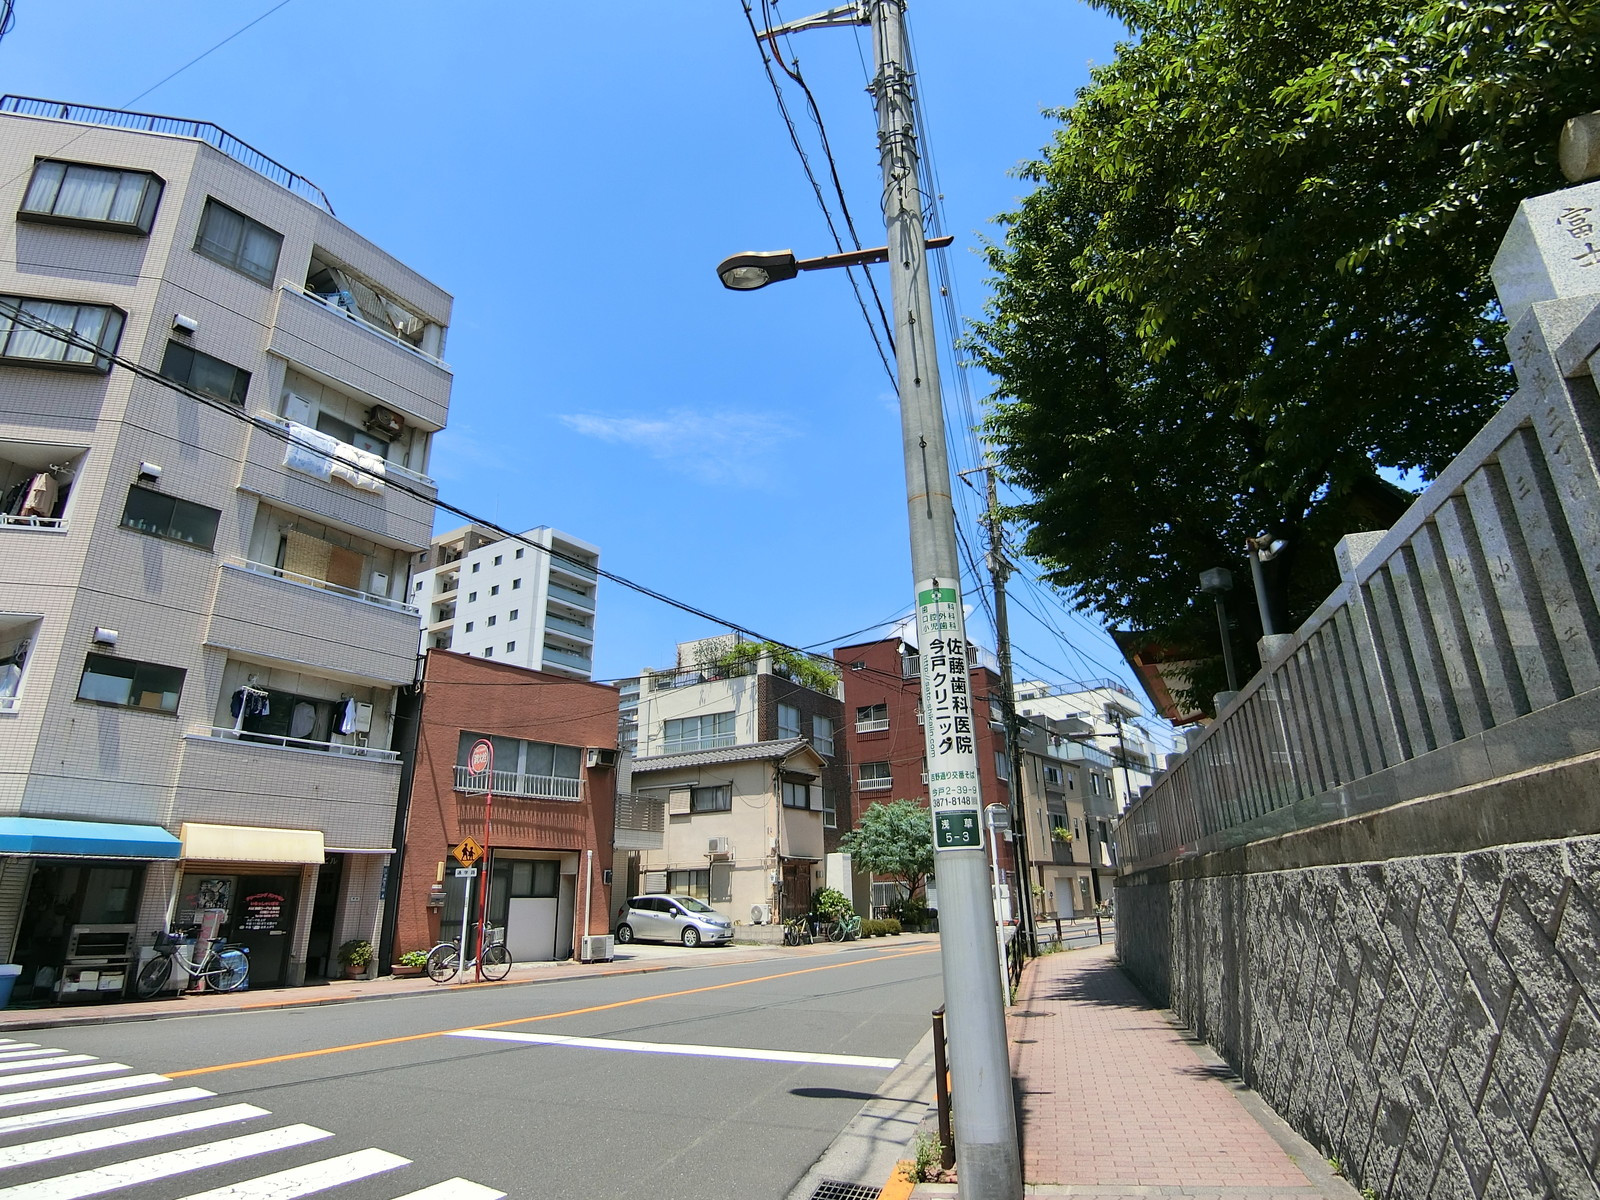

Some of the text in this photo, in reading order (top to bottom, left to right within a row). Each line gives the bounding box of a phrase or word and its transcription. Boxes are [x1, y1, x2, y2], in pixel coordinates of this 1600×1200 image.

[922, 612, 955, 623] 口腔外科
[922, 621, 957, 633] 小児歯科
[929, 638, 953, 755] 今戸クリニック
[946, 637, 973, 754] 佐藤歯科医院
[932, 785, 977, 797] 今戸2-39-9
[932, 796, 971, 808] 3871-8148
[945, 831, 970, 843] 5-3
